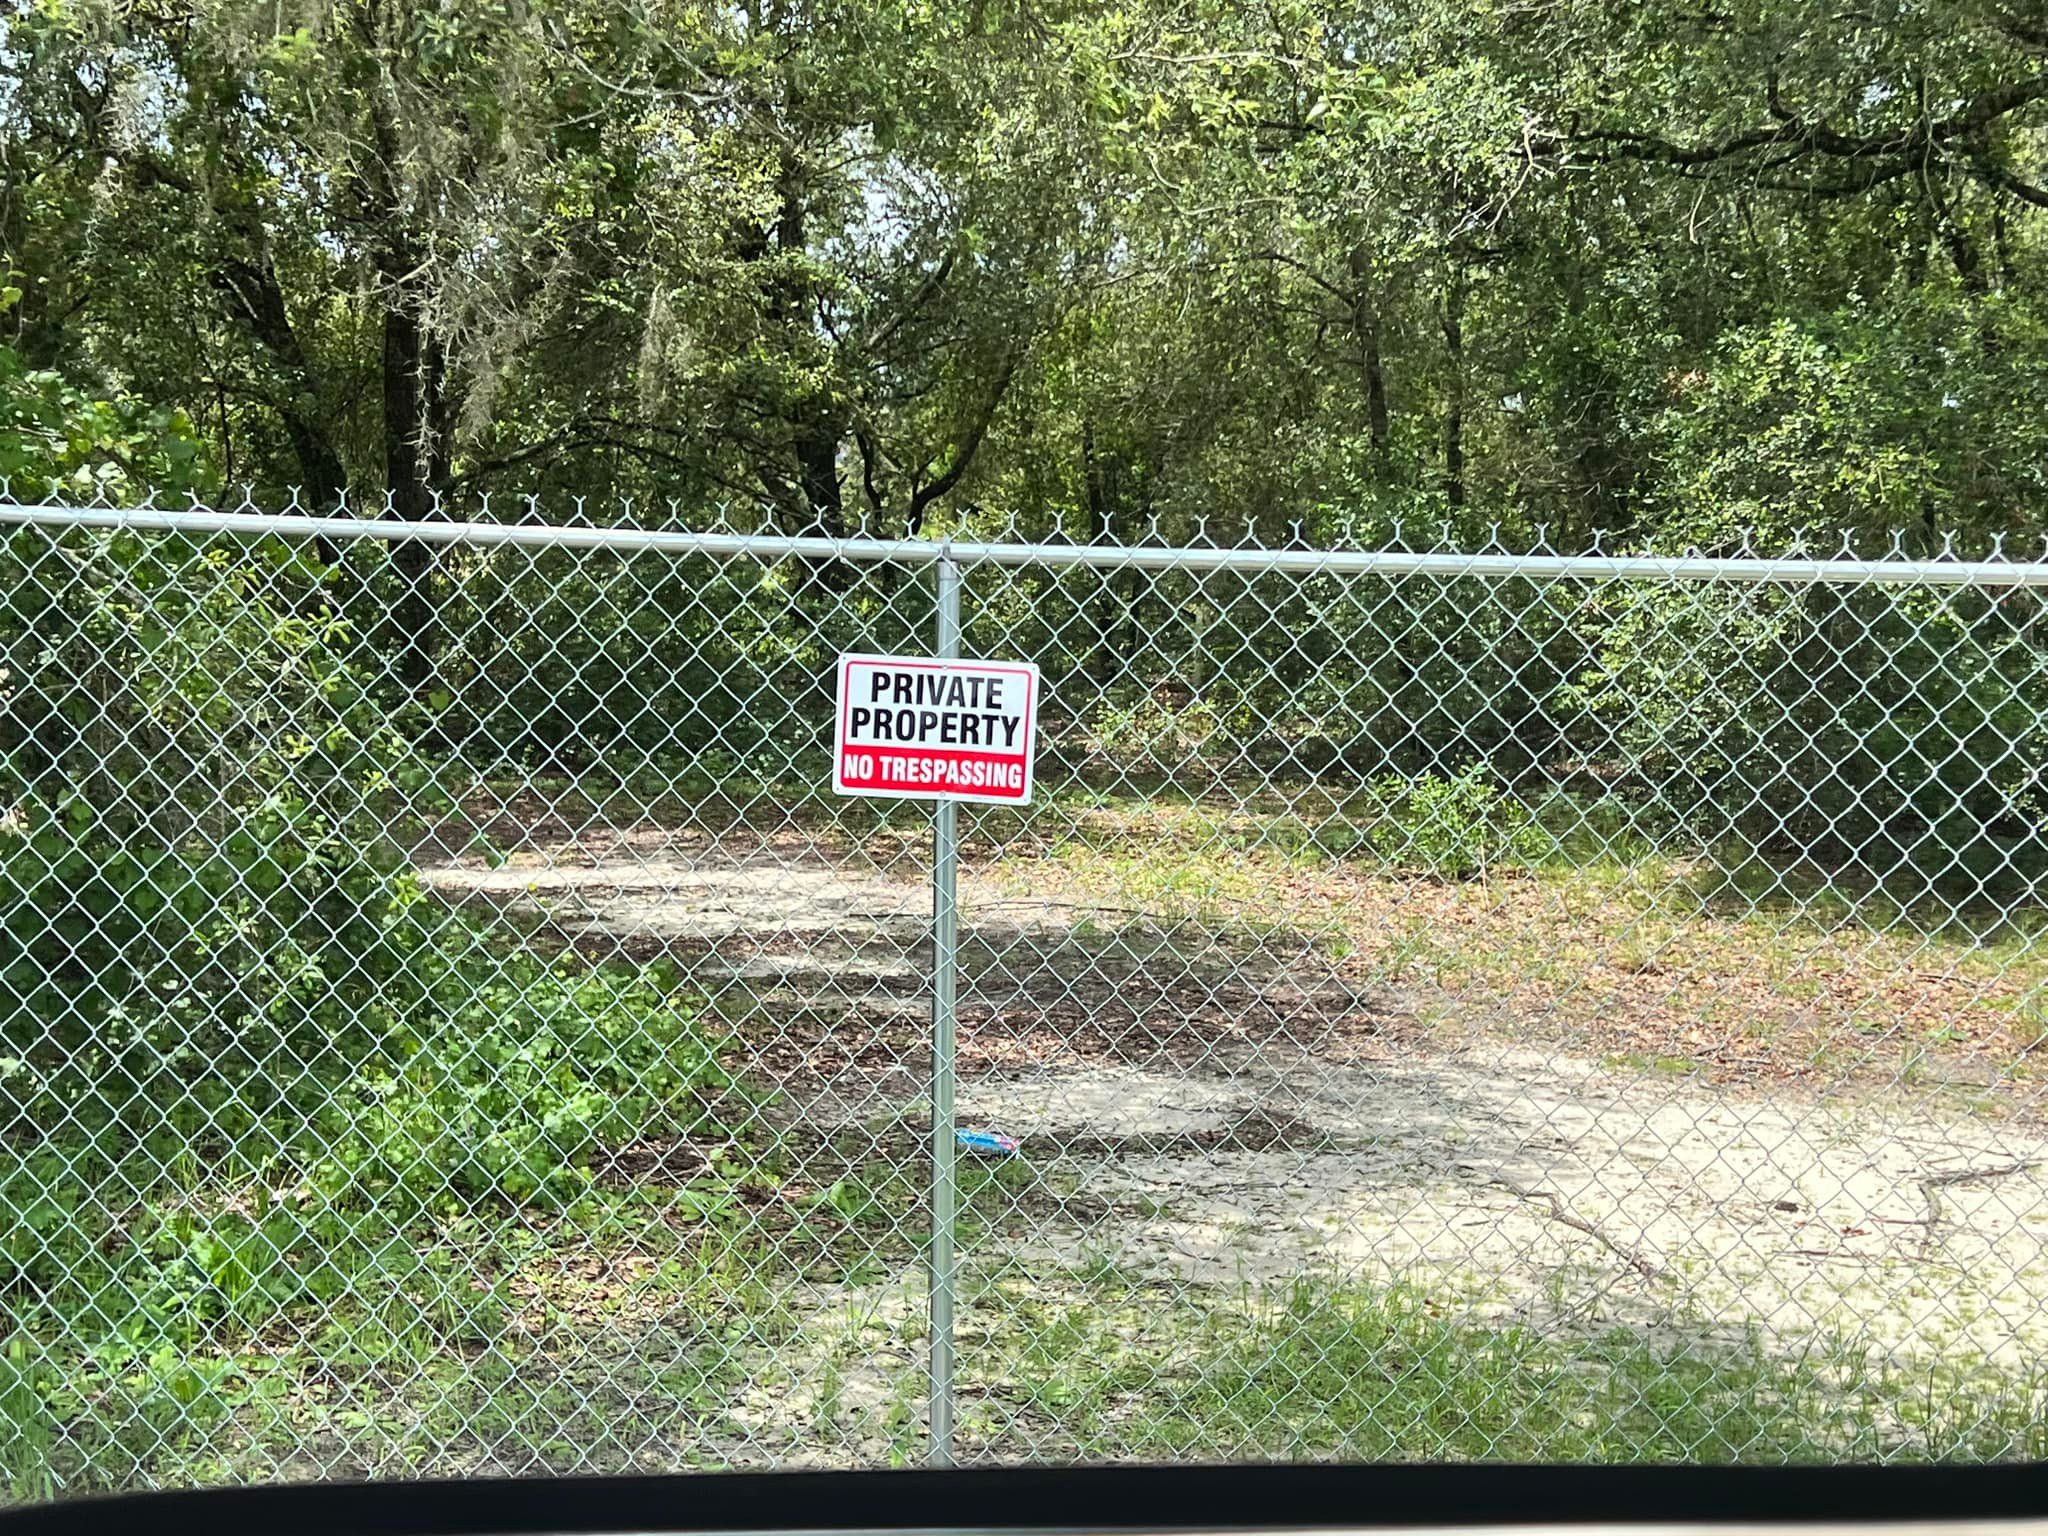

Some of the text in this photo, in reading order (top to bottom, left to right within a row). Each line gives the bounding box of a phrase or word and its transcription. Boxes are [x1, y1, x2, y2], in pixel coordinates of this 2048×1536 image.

[871, 671, 1003, 710] PRIVATE
[851, 707, 1020, 747] PROPERTY
[844, 753, 1023, 789] NO TRESPASSING
